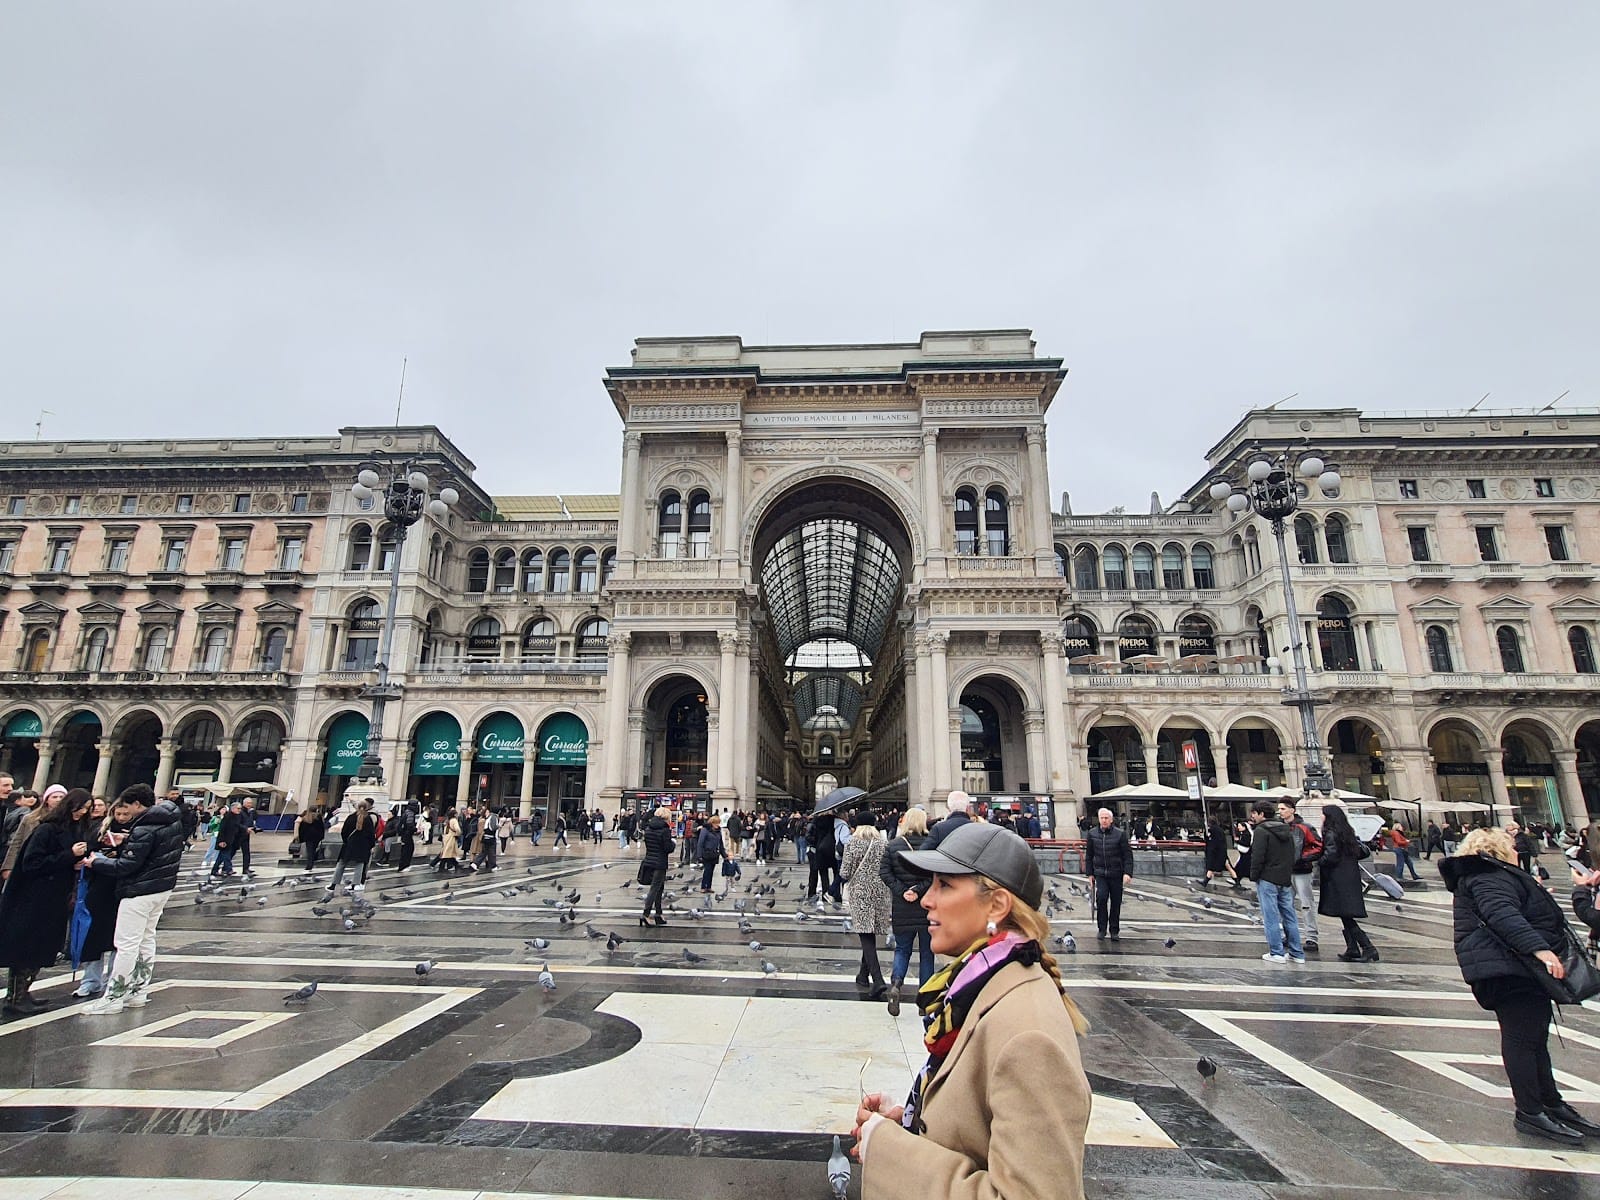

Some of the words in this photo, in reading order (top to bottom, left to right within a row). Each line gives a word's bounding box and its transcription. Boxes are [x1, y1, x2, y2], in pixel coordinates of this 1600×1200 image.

[1120, 637, 1149, 647] APEROL
[1180, 637, 1209, 647] APEROL
[1184, 748, 1196, 765] M
